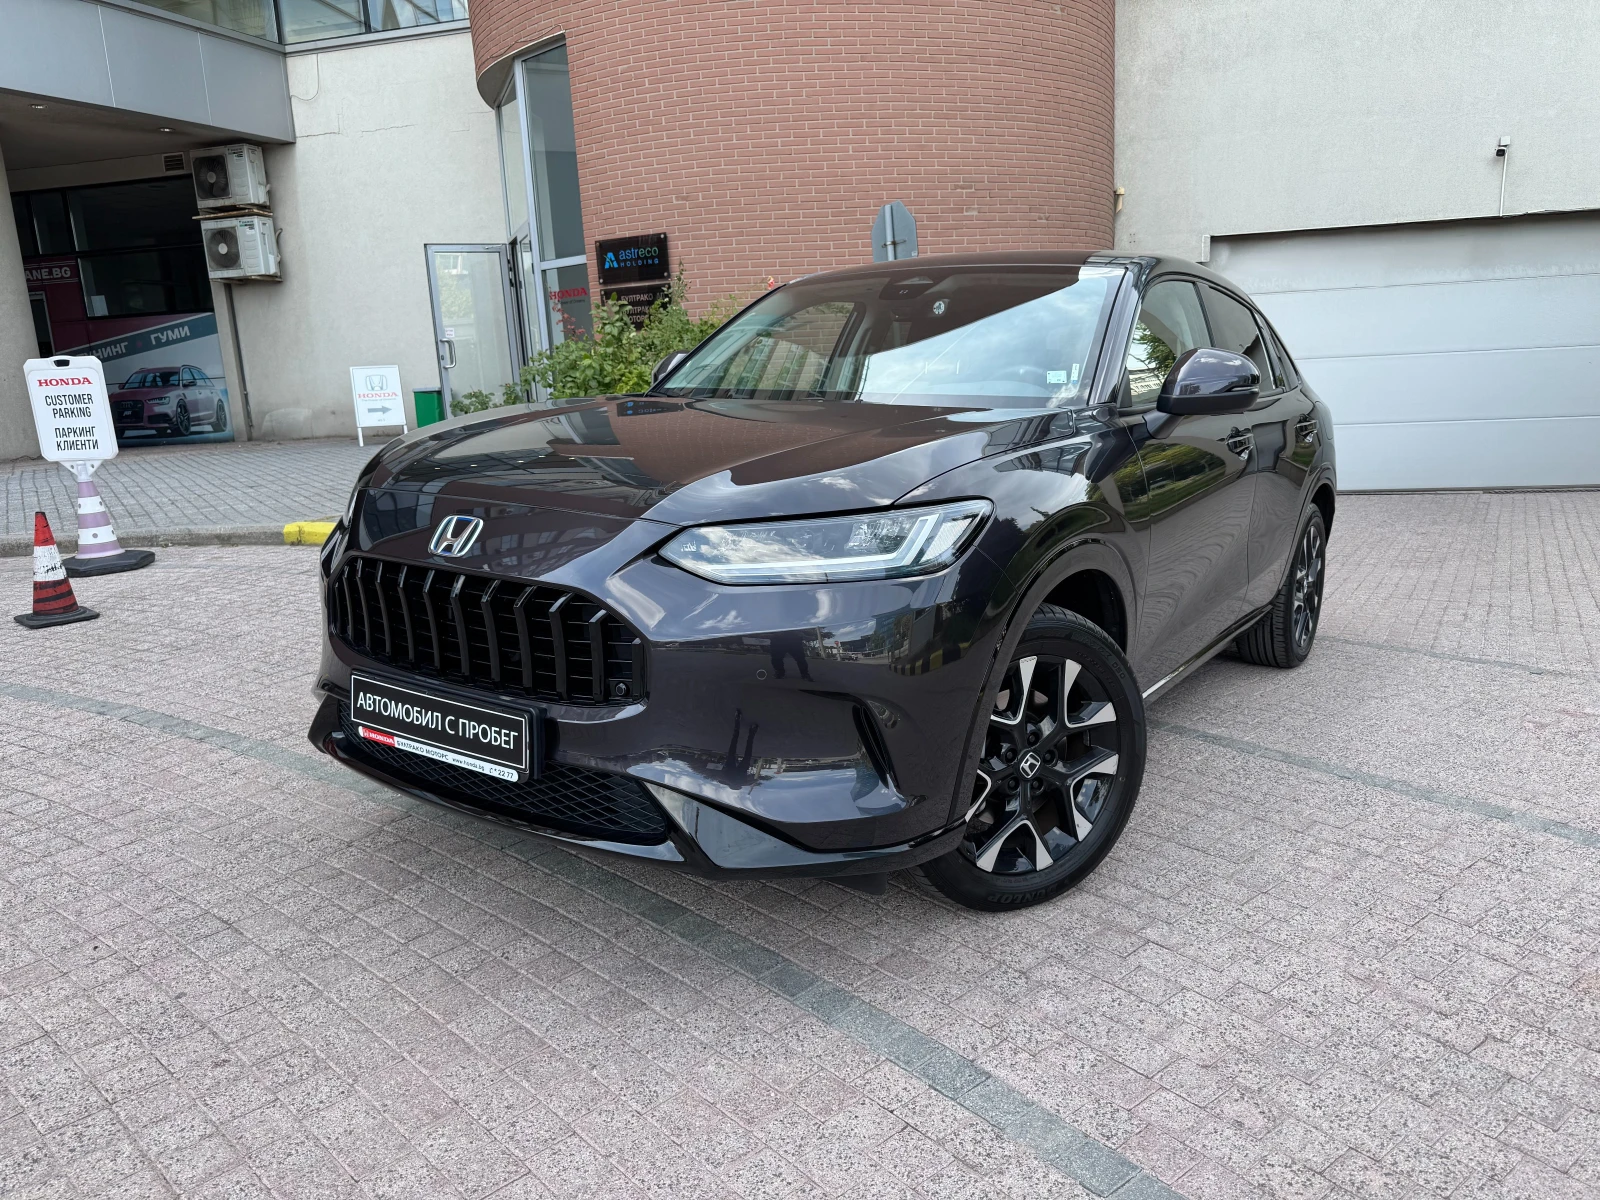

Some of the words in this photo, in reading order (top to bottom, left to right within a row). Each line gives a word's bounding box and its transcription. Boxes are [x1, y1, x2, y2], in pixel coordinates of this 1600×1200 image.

[619, 247, 658, 259] astreco
[620, 259, 658, 267] HOLDING
[550, 288, 587, 299] HONDA
[150, 325, 190, 345] ГУМИ
[37, 376, 93, 387] HONDA
[44, 393, 94, 406] CUSTOMER
[52, 406, 92, 419] PARKING
[54, 426, 96, 439] ПАРКИНГ
[56, 439, 99, 452] КЛИЕНТИ
[356, 691, 442, 731] АВТОМОБИЛ
[445, 715, 456, 735] С
[459, 718, 519, 750] ПРОБЕГ
[369, 732, 395, 744] HONDA
